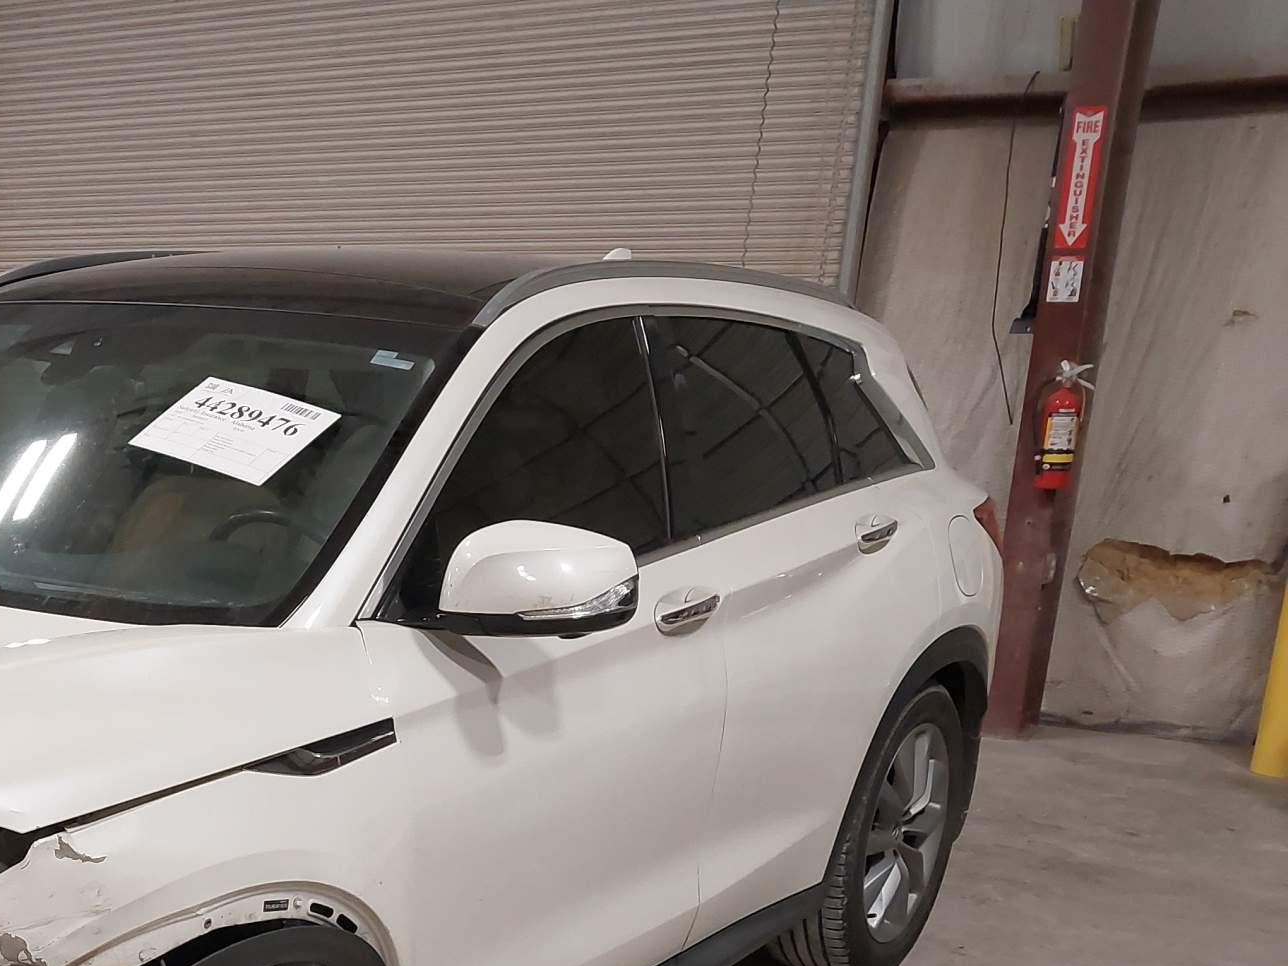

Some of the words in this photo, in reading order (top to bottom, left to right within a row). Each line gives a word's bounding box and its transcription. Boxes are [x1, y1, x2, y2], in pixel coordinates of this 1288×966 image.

[1076, 120, 1100, 134] FIRE
[1067, 138, 1090, 238] EXTINGUISHER
[194, 396, 305, 437] 44289476
